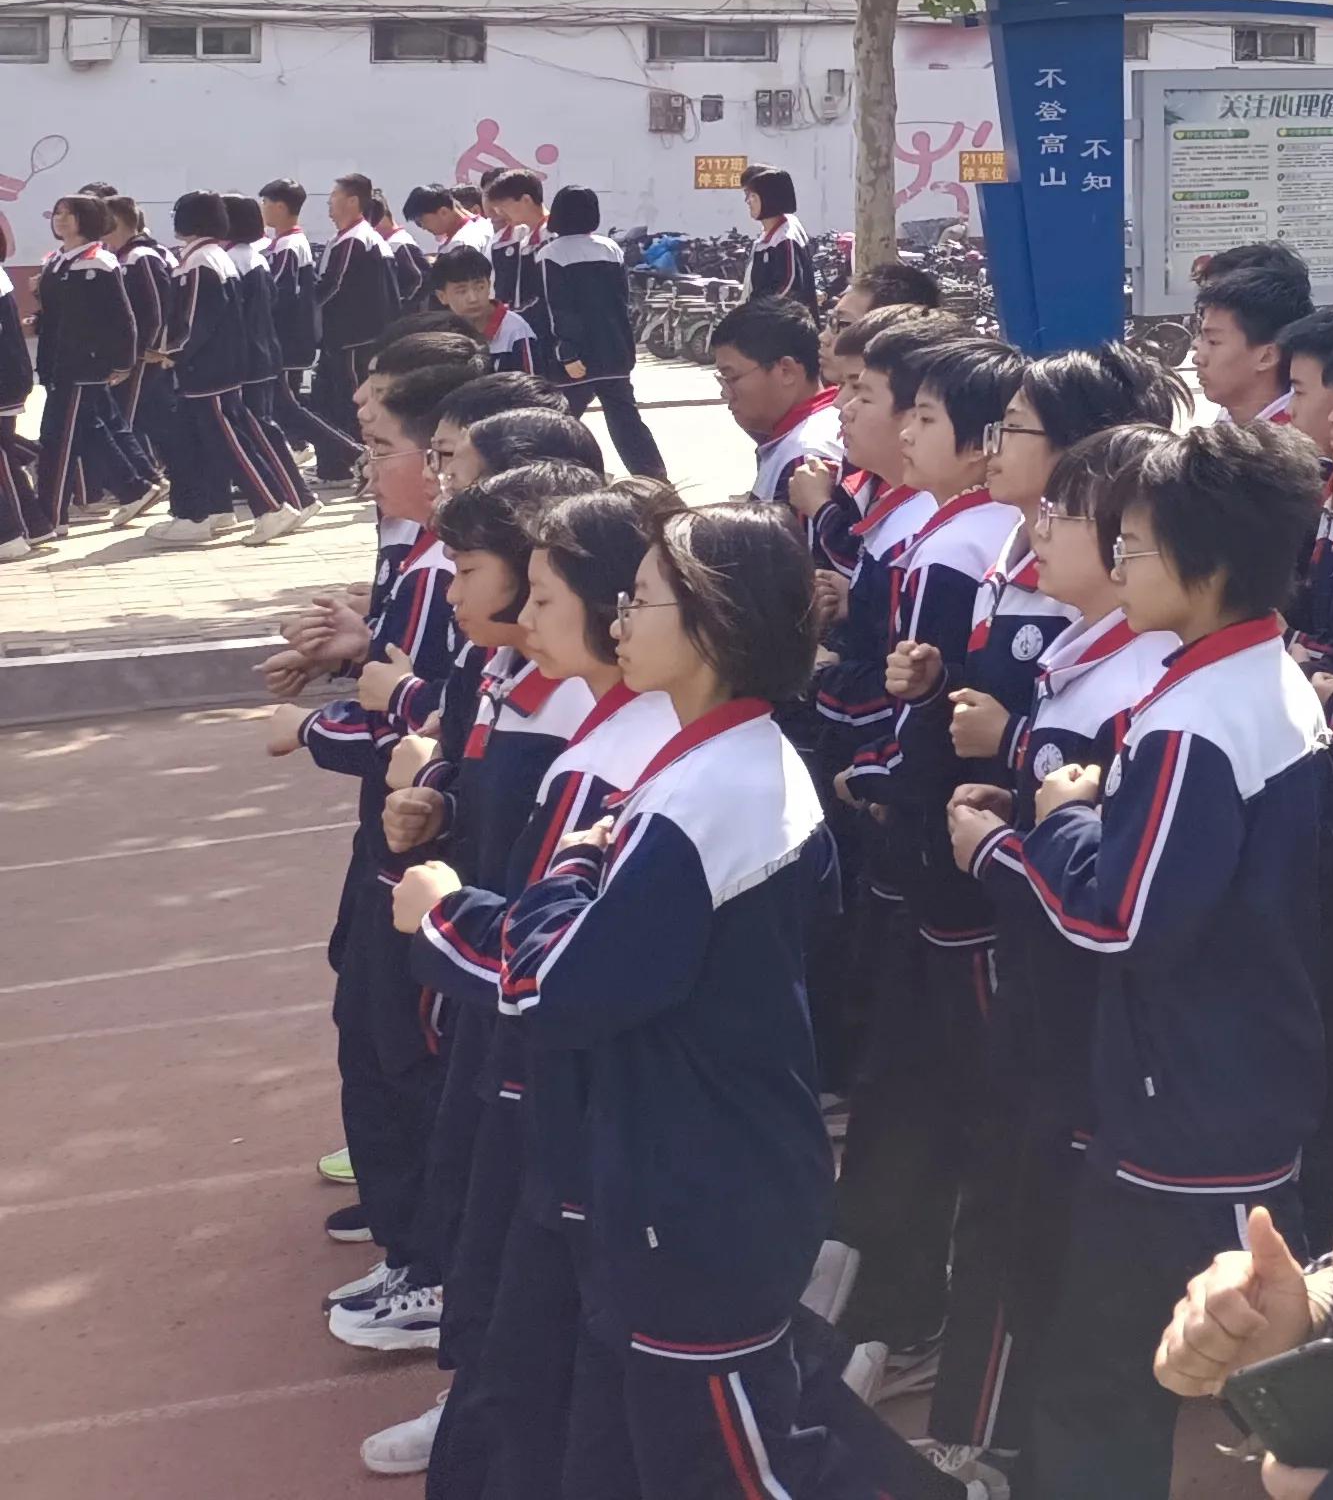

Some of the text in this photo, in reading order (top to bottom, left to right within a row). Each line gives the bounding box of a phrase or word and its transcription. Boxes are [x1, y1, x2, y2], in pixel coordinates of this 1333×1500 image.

[1034, 68, 1068, 187] 不登高山
[697, 157, 744, 171] 2117班
[961, 152, 1004, 165] 2116班
[1080, 139, 1112, 192] 不知
[697, 172, 742, 188] 停车位
[962, 166, 1004, 181] 停车位
